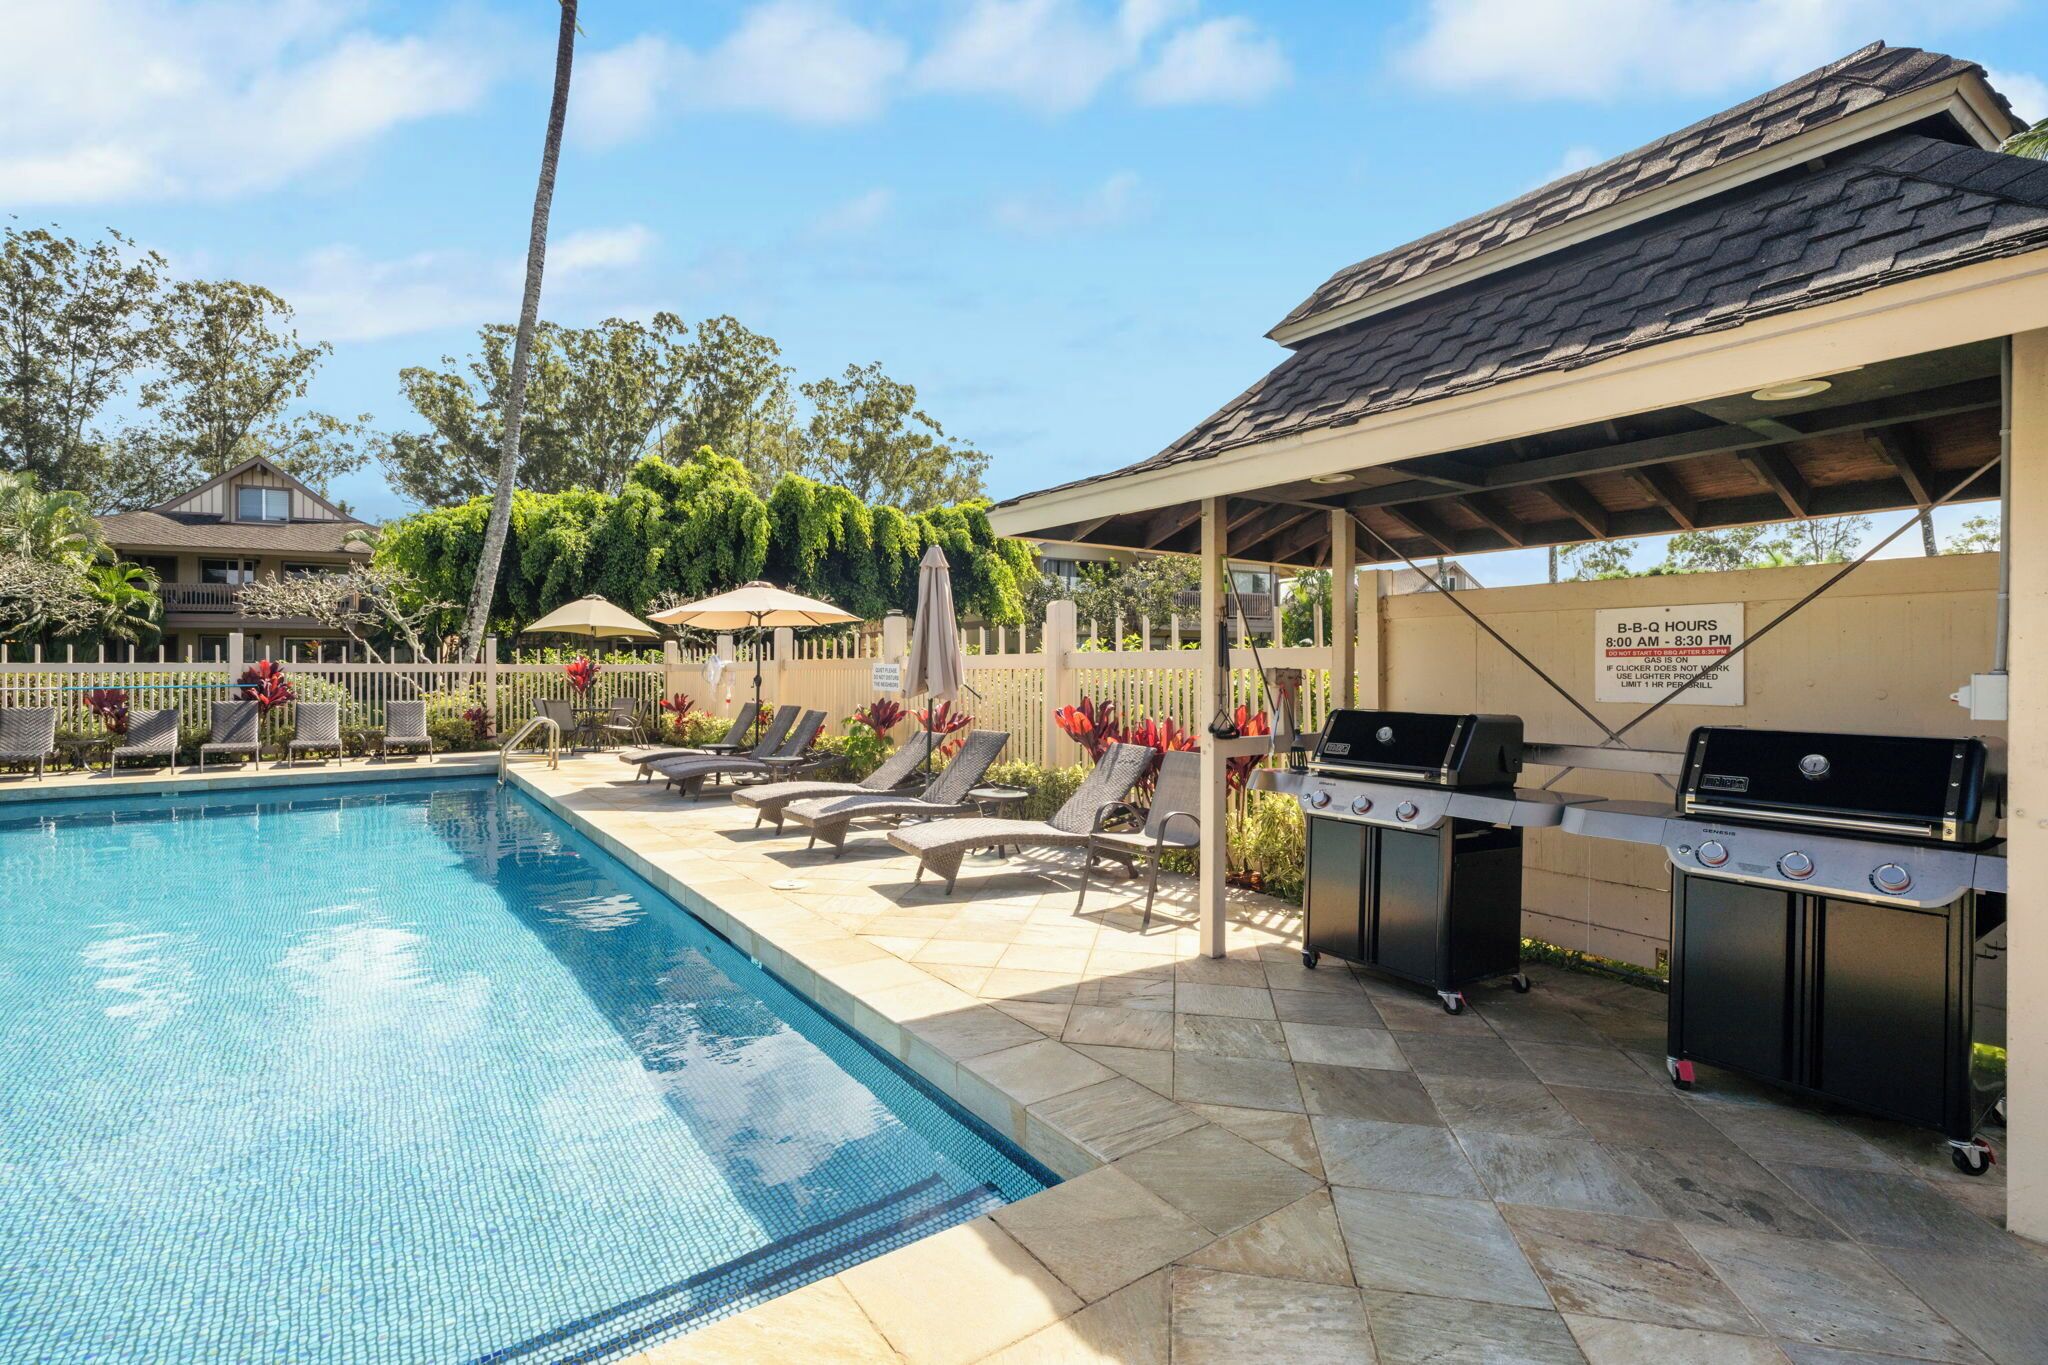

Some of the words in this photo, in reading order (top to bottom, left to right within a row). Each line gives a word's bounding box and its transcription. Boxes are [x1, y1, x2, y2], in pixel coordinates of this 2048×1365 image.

[1618, 622, 1659, 633] B-B-Q
[1665, 620, 1718, 632] HOURS
[1606, 637, 1632, 647] 8:00
[1637, 636, 1659, 646] AM
[1675, 636, 1702, 646] 8:30
[1709, 635, 1731, 645] PM
